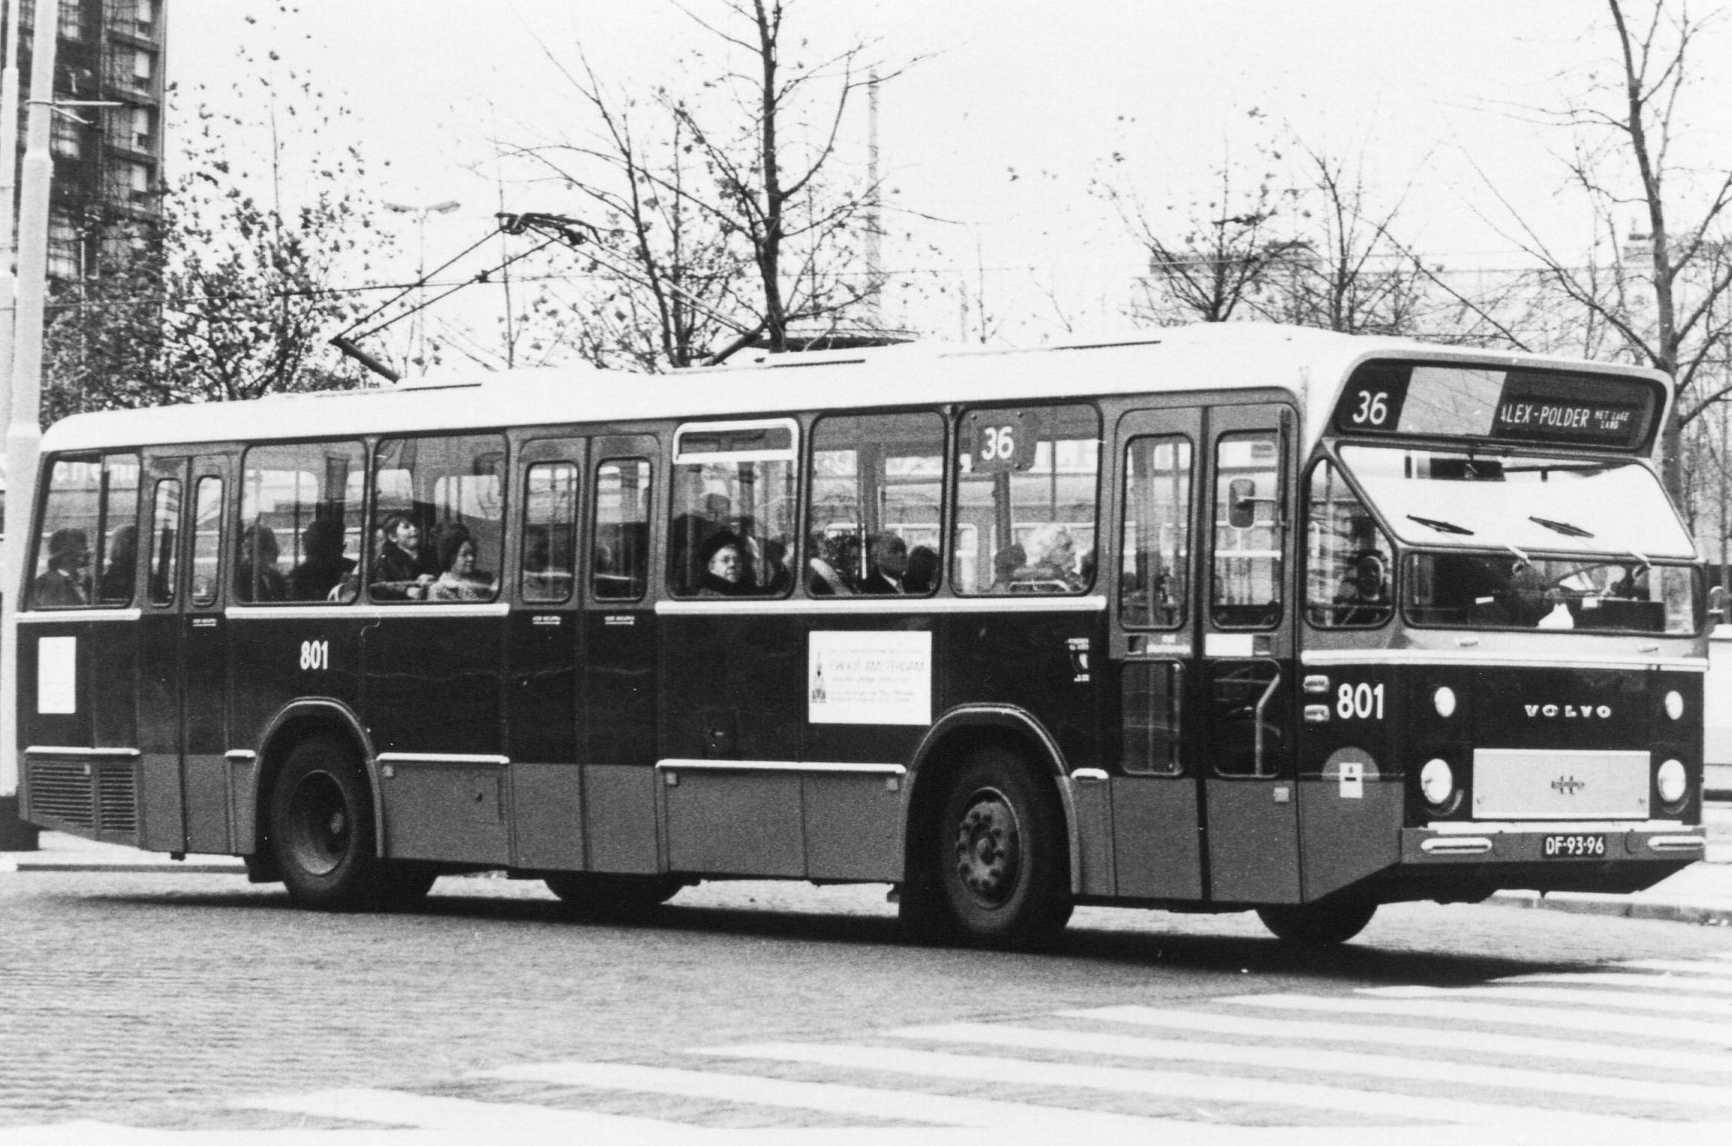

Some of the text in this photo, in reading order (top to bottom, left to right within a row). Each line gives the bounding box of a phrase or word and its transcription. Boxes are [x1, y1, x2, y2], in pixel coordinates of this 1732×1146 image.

[1352, 390, 1388, 425] 36
[981, 426, 1014, 460] 36
[300, 640, 329, 670] 801
[1336, 682, 1385, 719] 801
[1524, 704, 1612, 718] VOLVO
